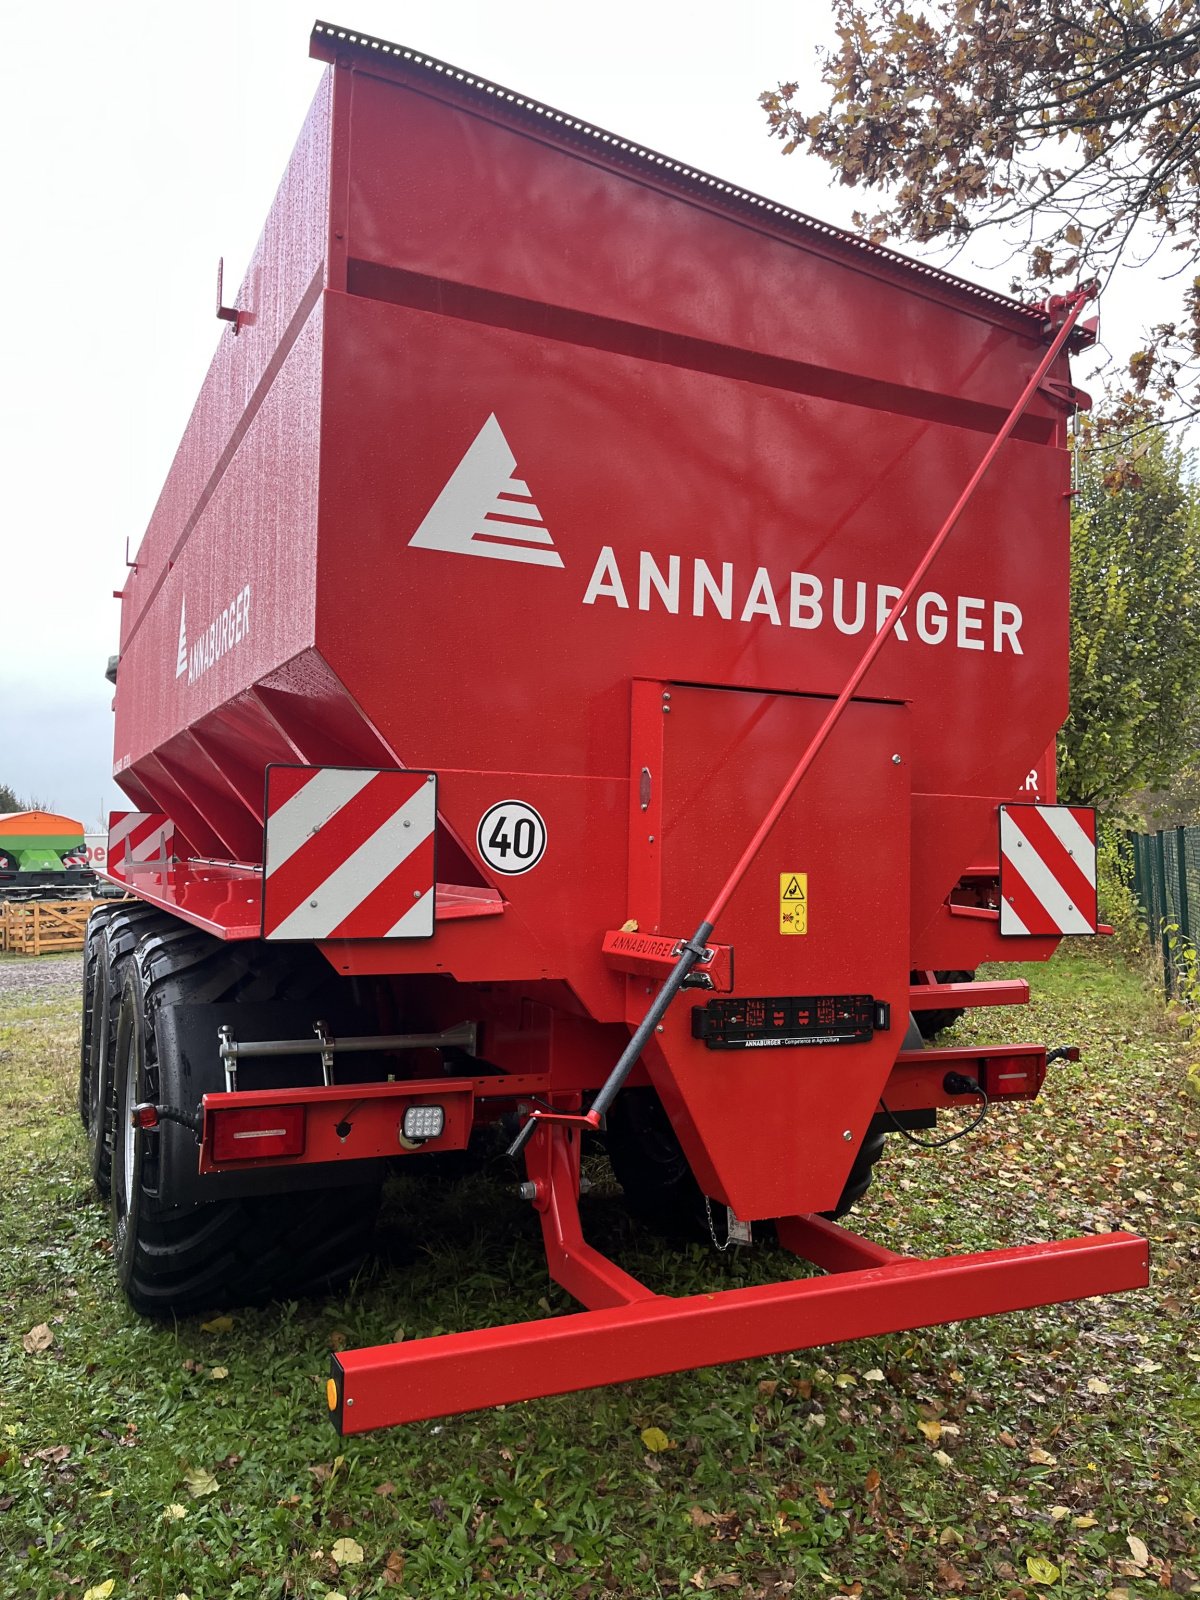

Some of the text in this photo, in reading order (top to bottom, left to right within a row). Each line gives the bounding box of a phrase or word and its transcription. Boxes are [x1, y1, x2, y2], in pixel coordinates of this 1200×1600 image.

[582, 545, 1024, 655] ANNABURGER
[187, 584, 250, 687] ANNABURGER
[1018, 769, 1039, 791] R
[488, 816, 536, 859] 40
[745, 1039, 781, 1047] ANNABURGER
[816, 1037, 840, 1045] Agriculture
